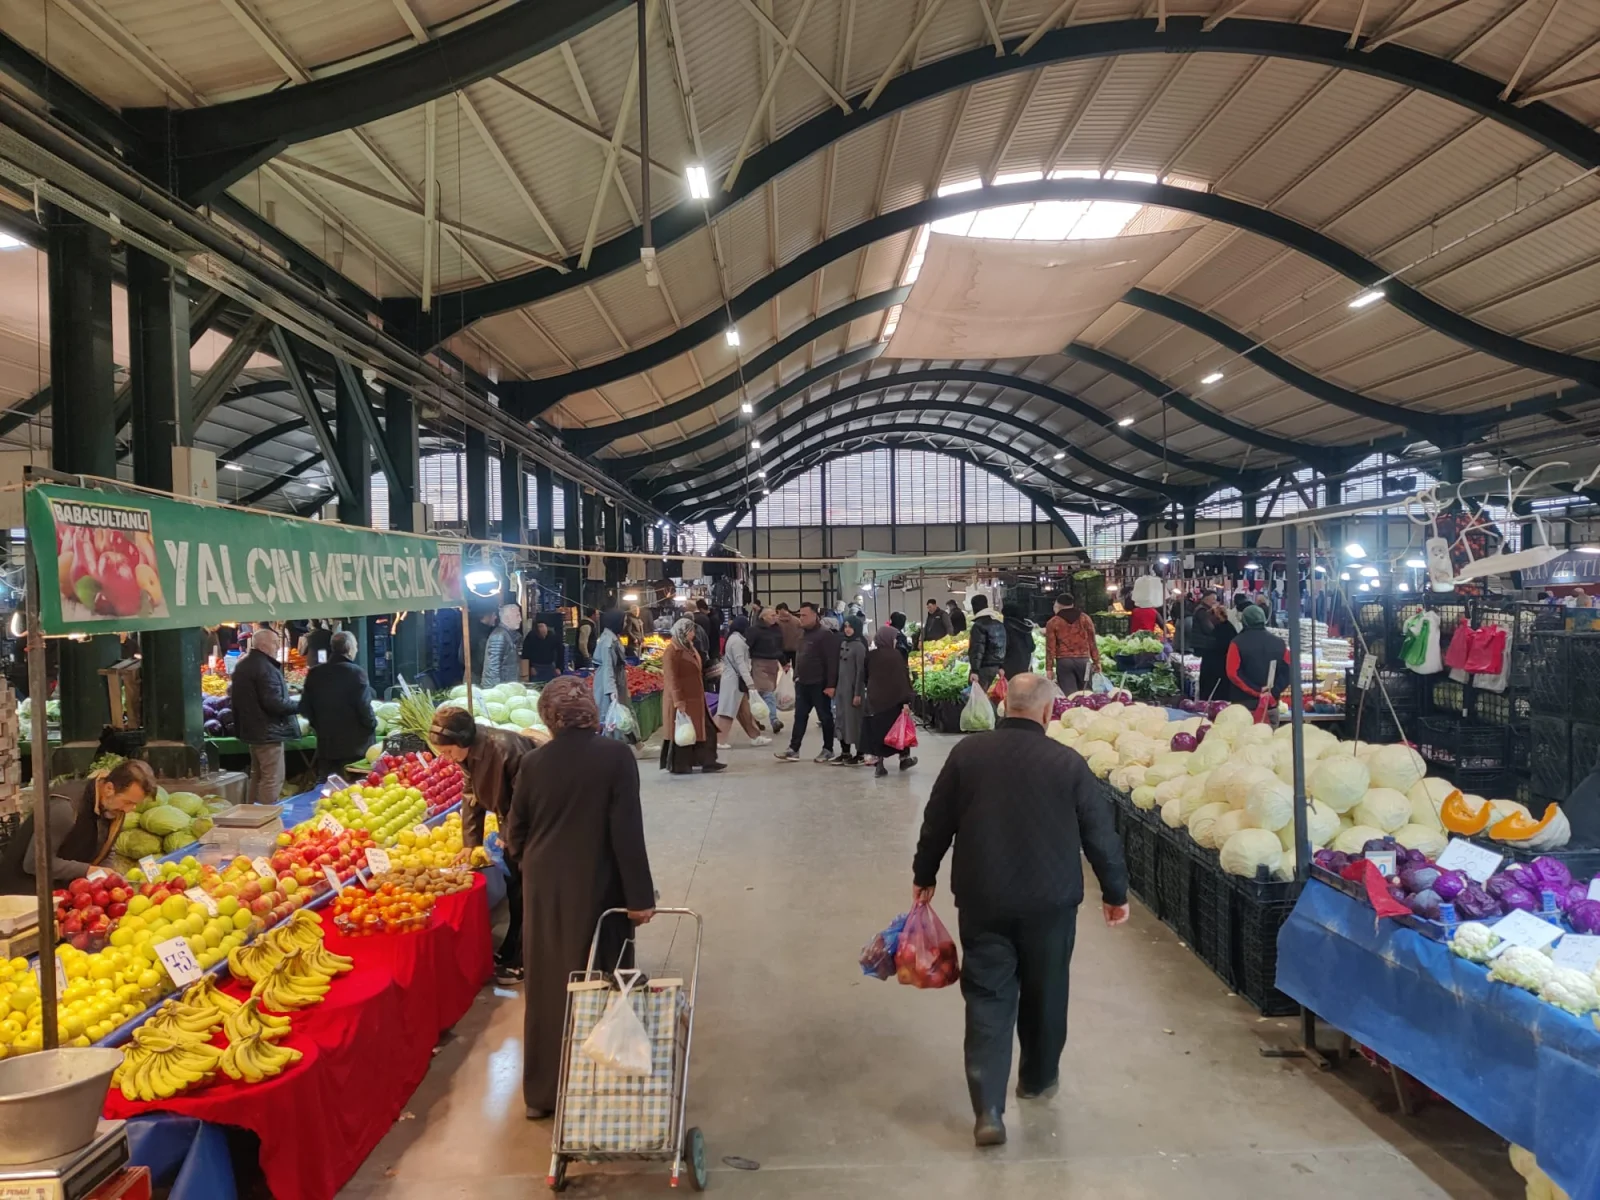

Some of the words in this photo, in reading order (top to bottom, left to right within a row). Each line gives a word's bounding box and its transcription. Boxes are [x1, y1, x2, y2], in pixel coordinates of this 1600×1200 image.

[53, 503, 148, 530] BABASULTANLI
[163, 540, 308, 615] YALÇIN
[309, 547, 442, 602] MEYVECİLİK
[1552, 556, 1600, 578] ZEYTİ
[164, 950, 192, 974] 75
